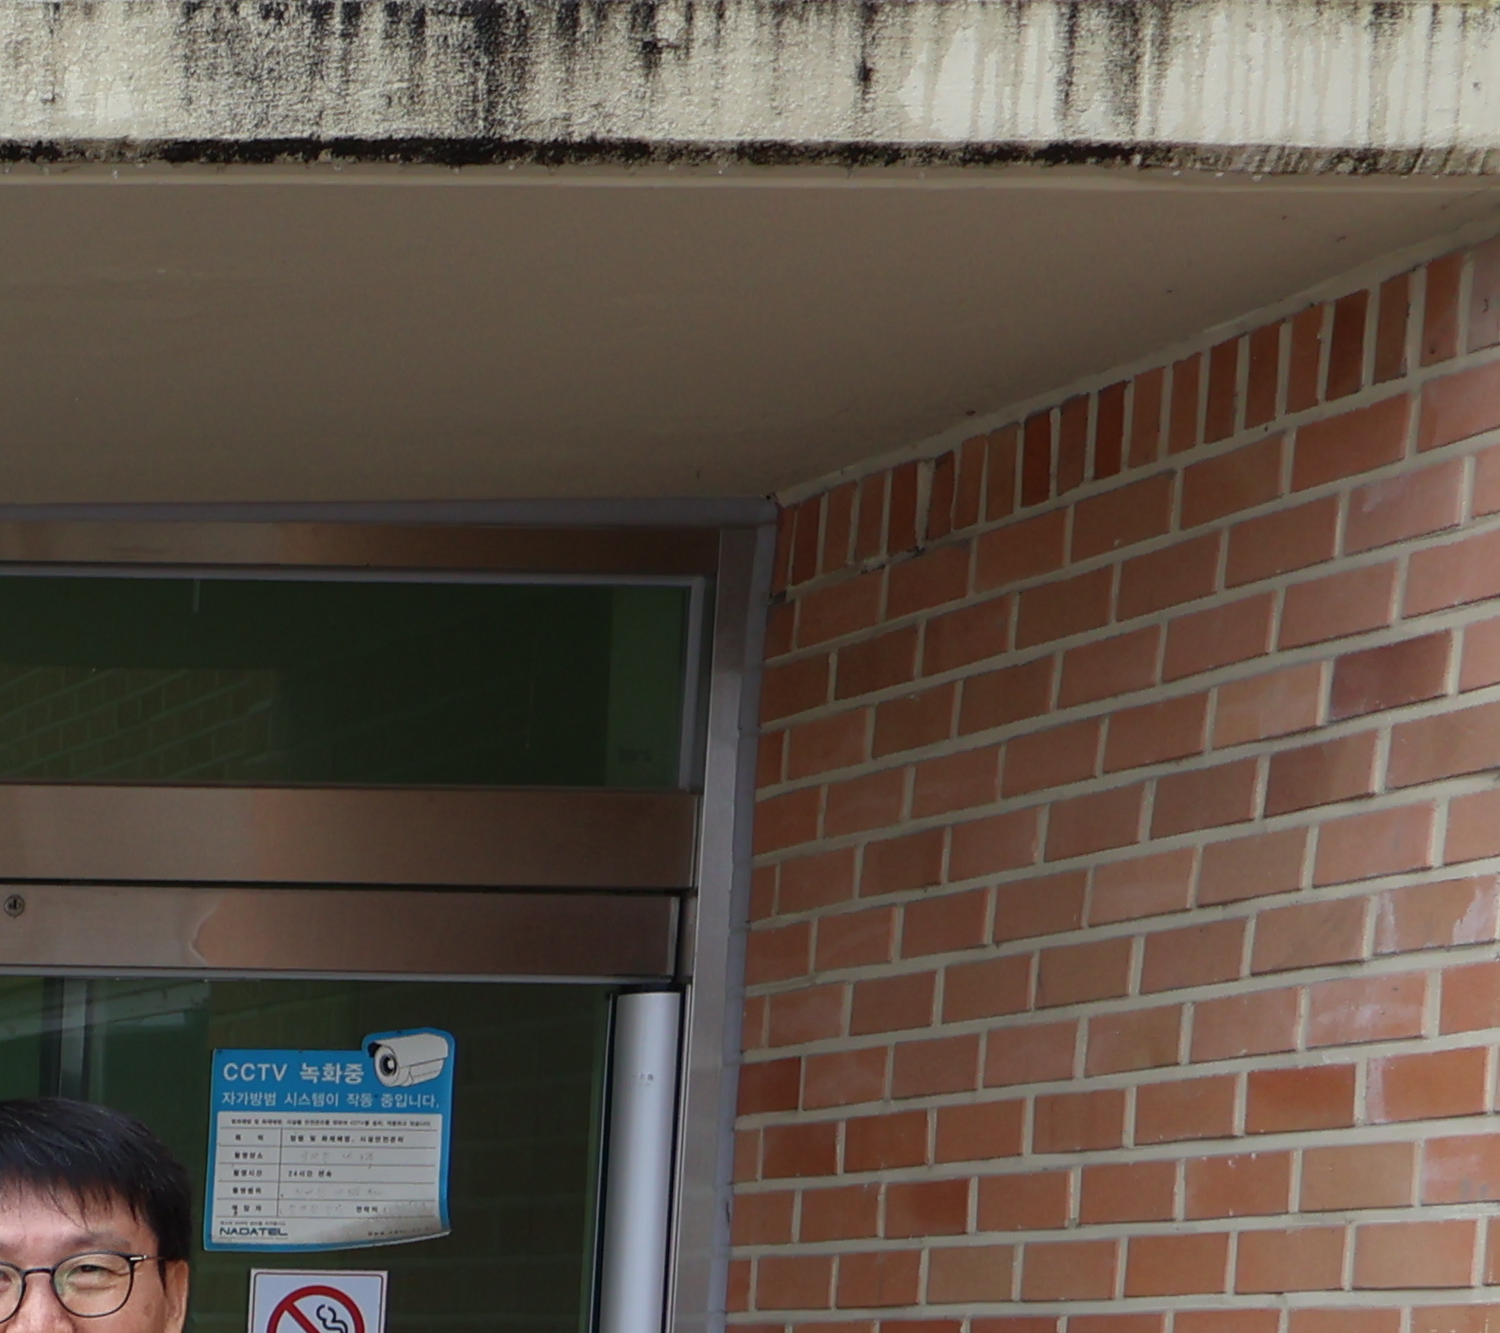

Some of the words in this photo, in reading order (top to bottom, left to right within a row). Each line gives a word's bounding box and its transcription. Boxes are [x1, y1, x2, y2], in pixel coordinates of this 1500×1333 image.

[223, 1063, 288, 1081] CCTV
[300, 1064, 364, 1084] 녹화중
[222, 1092, 276, 1106] 자가방범
[285, 1092, 339, 1106] 시스템이
[346, 1094, 373, 1107] 작동
[220, 1227, 288, 1236] NADATEL
